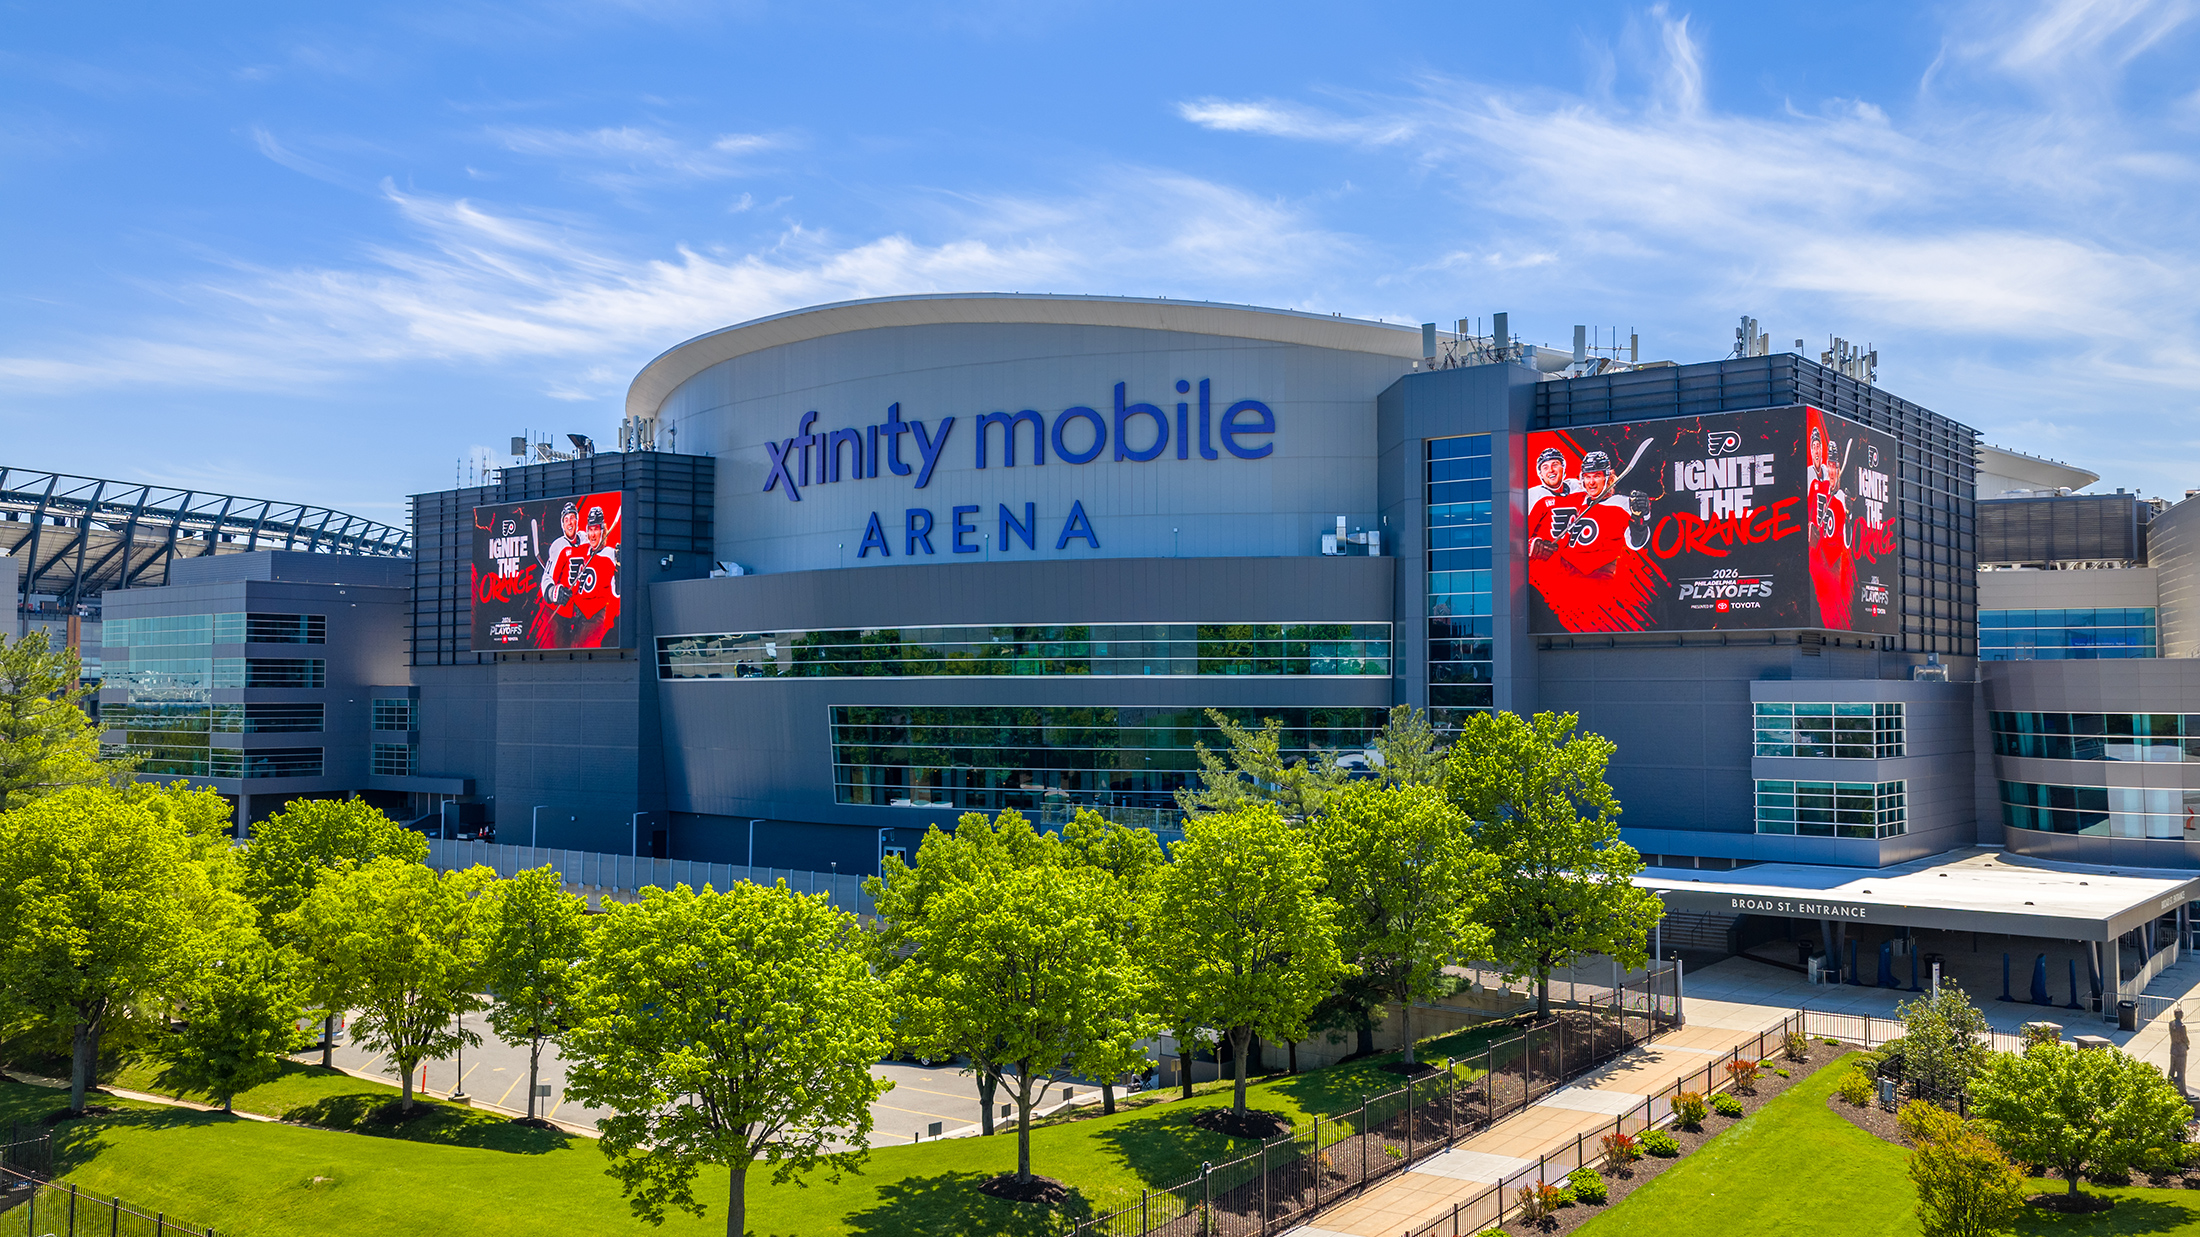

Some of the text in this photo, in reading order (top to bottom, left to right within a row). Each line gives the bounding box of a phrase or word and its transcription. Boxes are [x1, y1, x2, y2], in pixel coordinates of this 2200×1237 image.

[763, 378, 1276, 501] xfinity mobile
[1674, 453, 1775, 492] IGNITE
[1858, 466, 1889, 504] IGNITE
[1695, 487, 1754, 521] THE
[1865, 498, 1884, 531] THE
[857, 500, 1099, 558] ARENA
[1651, 496, 1802, 559] ORANGE
[1852, 516, 1897, 565] ORANGE
[489, 535, 529, 559] IGNITE
[496, 557, 520, 579] THE
[1712, 568, 1739, 579] 2026
[479, 563, 538, 604] ORANGE
[1679, 580, 1774, 600] PLAYOFFS
[1694, 579, 1737, 587] PHILADELPHIA
[1861, 587, 1889, 606] PLAYOFFS
[1731, 601, 1761, 609] TOYOTA
[490, 624, 523, 636] PLAYOFFS
[1731, 898, 1866, 918] BROAD ST. ENTRANCE
